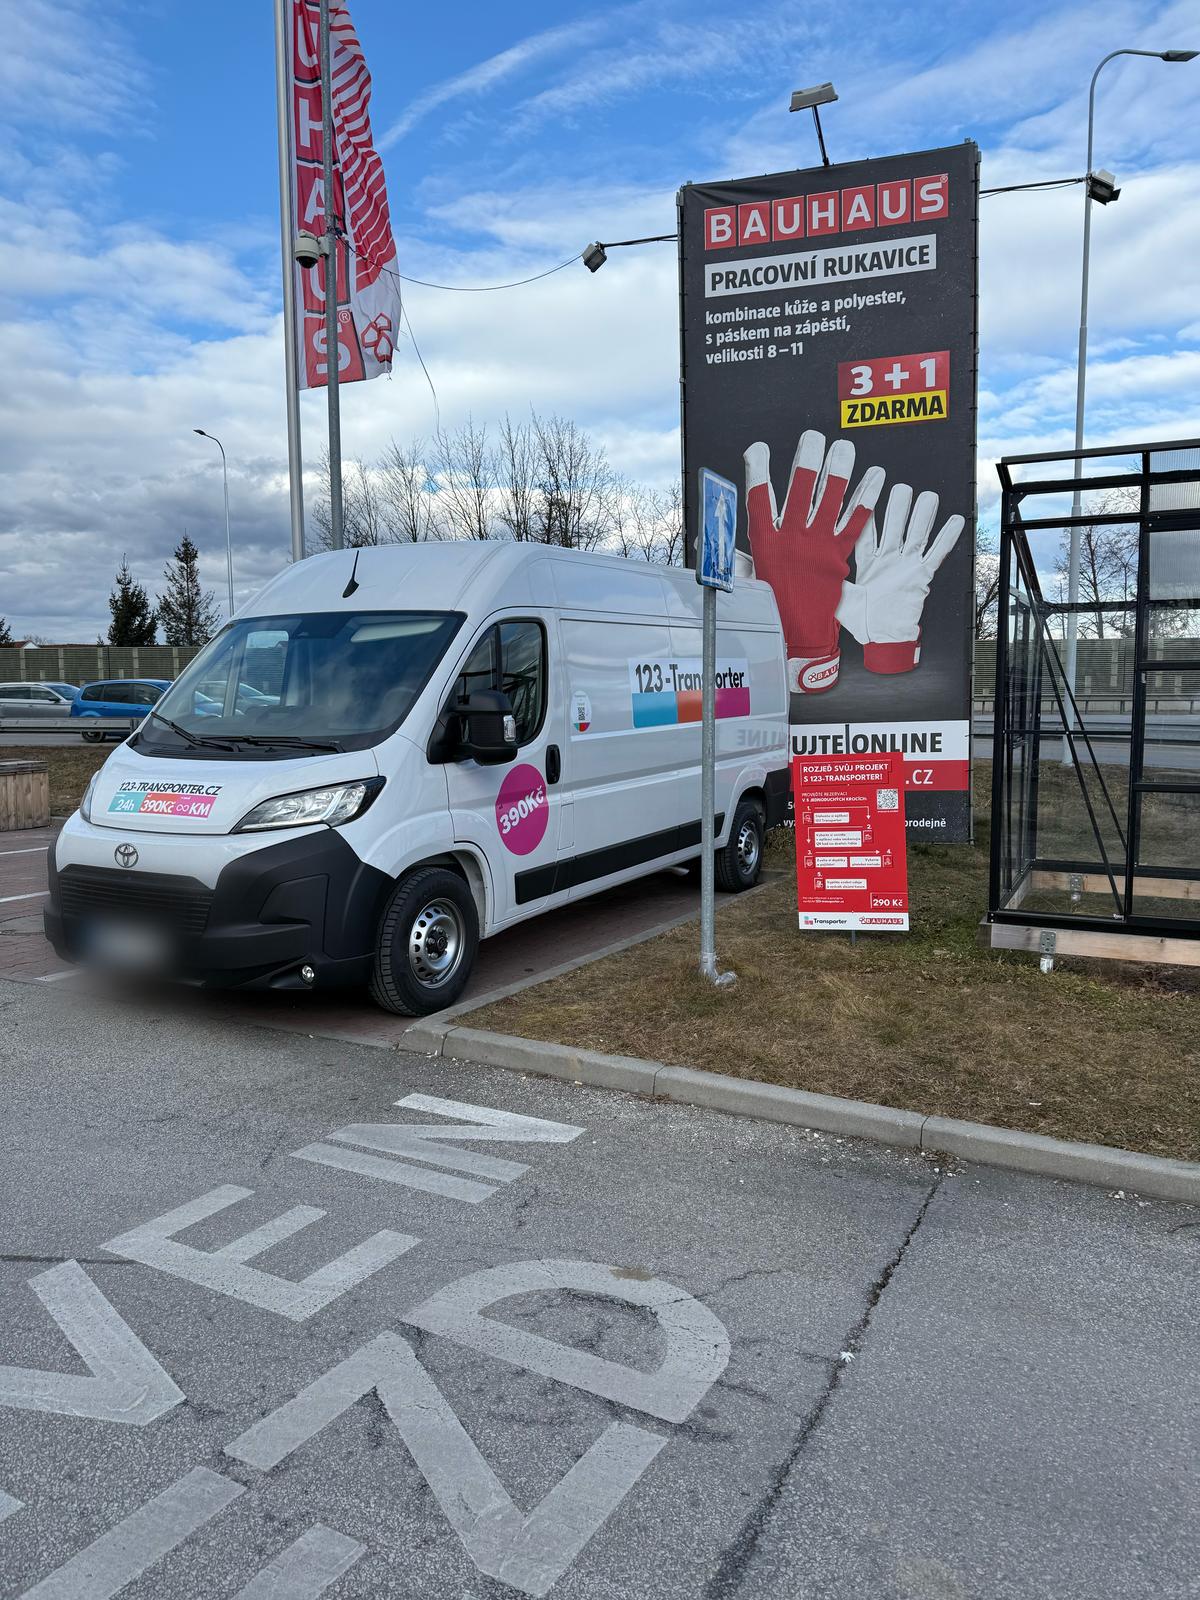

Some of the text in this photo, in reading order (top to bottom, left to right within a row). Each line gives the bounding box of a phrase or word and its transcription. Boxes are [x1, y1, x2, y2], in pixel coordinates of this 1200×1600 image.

[709, 181, 945, 243] BAUHAUS
[710, 244, 931, 291] PRACOVNÍ RUKAVICE
[705, 290, 907, 325] kombinace kůže a polyester,
[705, 315, 851, 346] s páskem na zápěstí,
[705, 345, 764, 365] velikosti
[849, 365, 874, 396] 3
[919, 358, 936, 387] 1
[846, 395, 944, 424] ZDARMA
[635, 663, 745, 693] 123-Tranorter
[851, 732, 943, 754] ONLINE
[803, 763, 889, 773] ROZJEĎ SVŮJ PROJEKT
[810, 773, 883, 782] 123-TRANSPORTER!
[119, 782, 222, 796] 123-TRANSPORTER.CZ
[115, 799, 135, 811] 24h
[140, 799, 176, 813] 390Kč
[499, 785, 544, 834] 390Kč
[872, 898, 903, 907] 290 Kč
